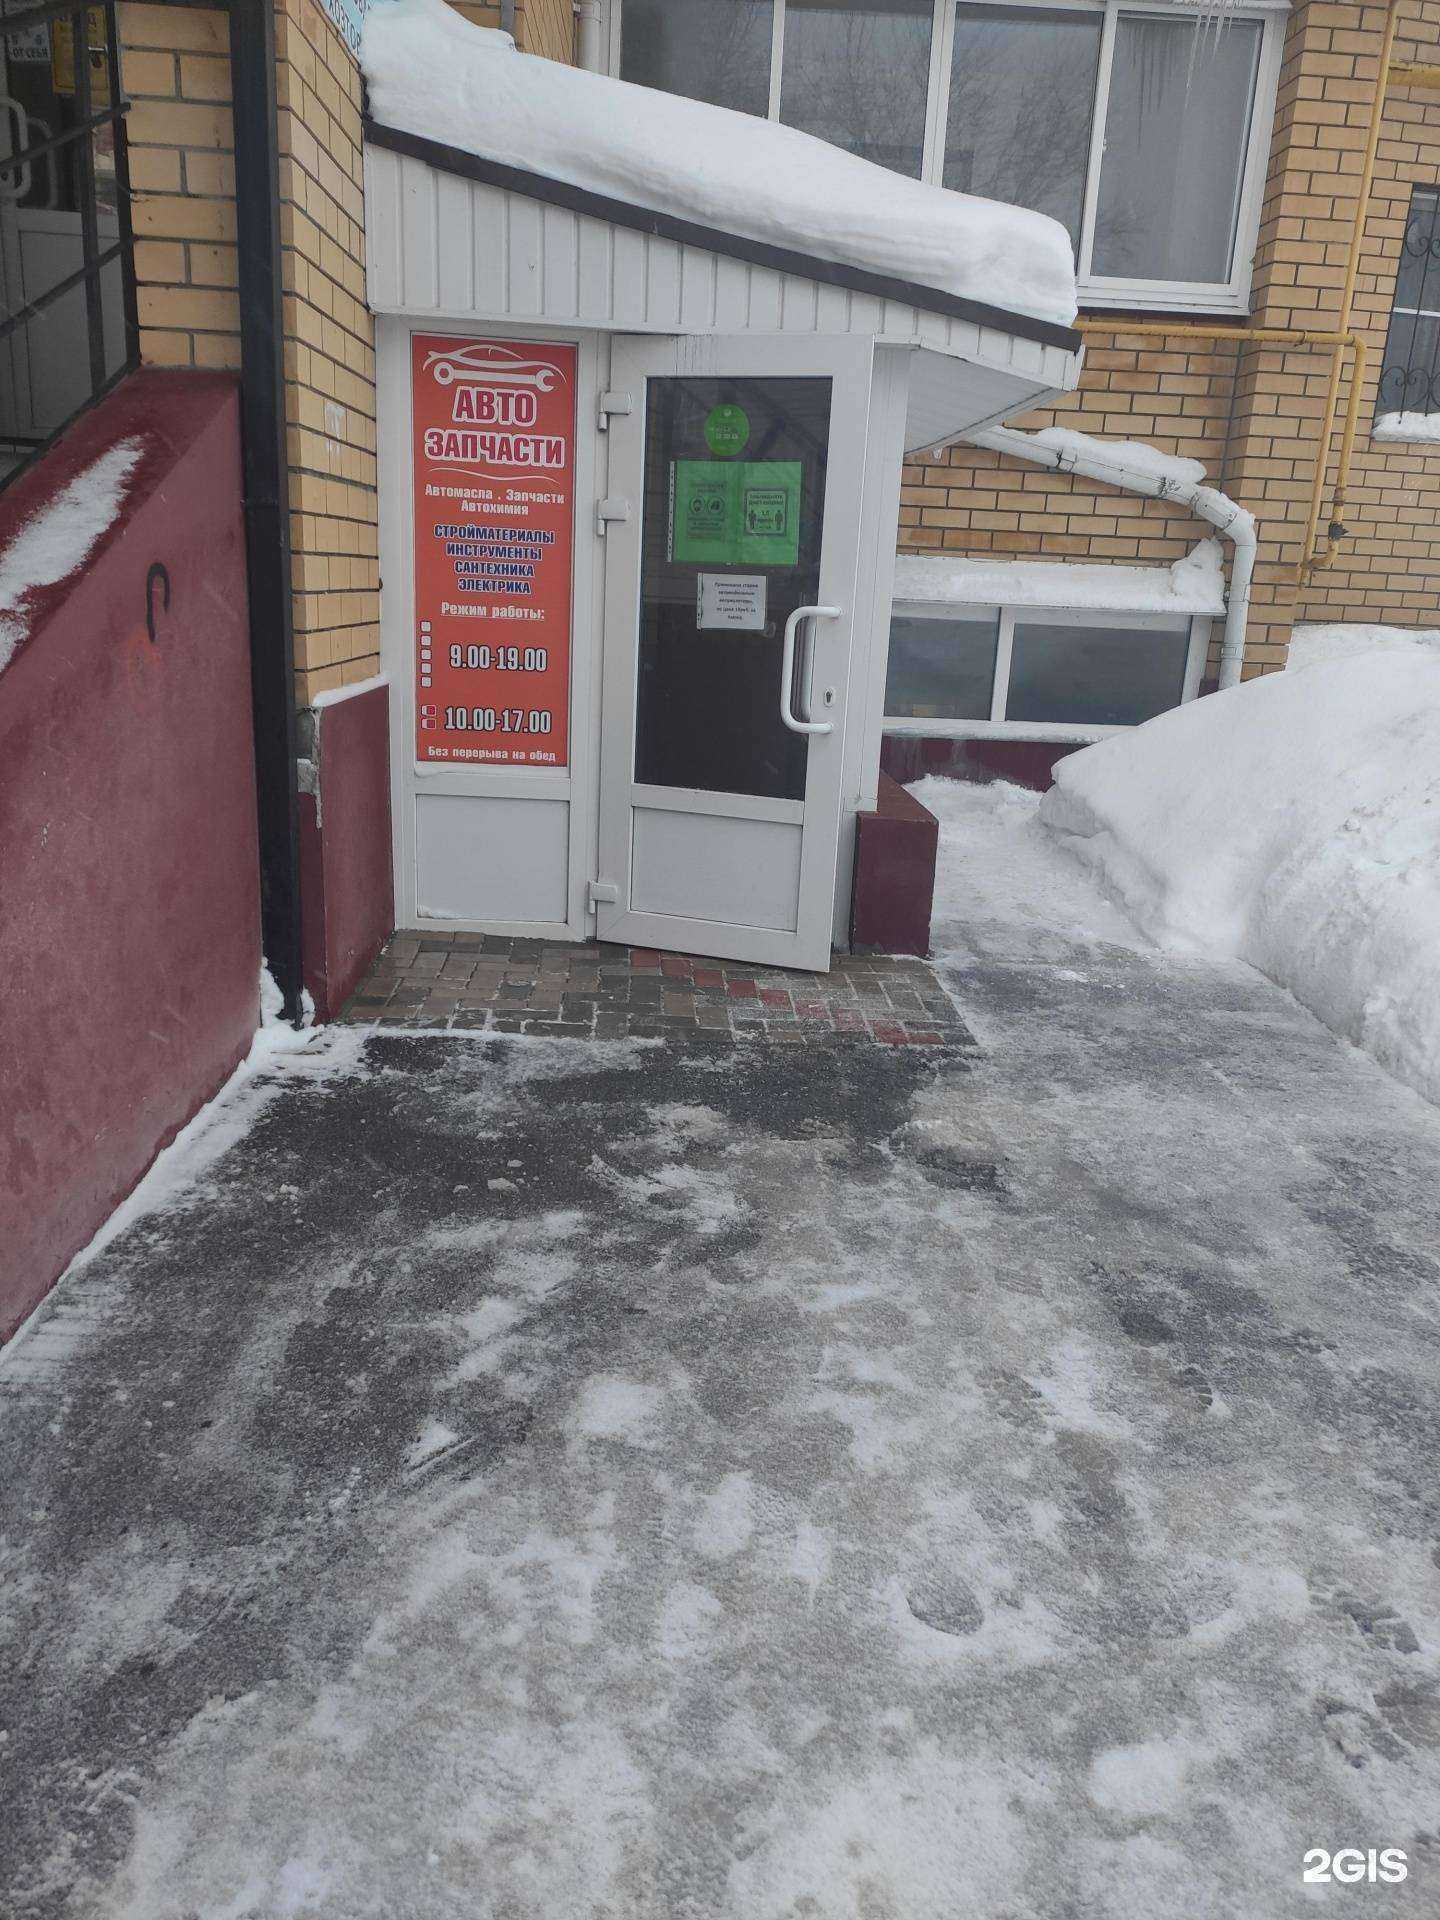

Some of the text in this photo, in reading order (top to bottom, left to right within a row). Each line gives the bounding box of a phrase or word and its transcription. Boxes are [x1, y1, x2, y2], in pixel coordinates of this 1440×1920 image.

[453, 386, 537, 427] АВТО
[425, 428, 565, 468] ЗАПЧАСТИ
[425, 484, 565, 504] Автомасла Запчасти
[461, 500, 529, 515] Автохимия
[434, 524, 555, 543] СТРОЙМАТЕРИАЛЫ
[446, 543, 543, 560] ИНСТРУМЕНТЫ
[454, 561, 535, 577] САНТЕХНИКА
[458, 578, 531, 594] ЭЛЕКТРИКА
[441, 602, 545, 620] Режим работы:
[450, 644, 547, 672] 9.00-19.00
[445, 707, 552, 734] 10.00-17.00
[428, 746, 556, 762] Без перерыва на обед
